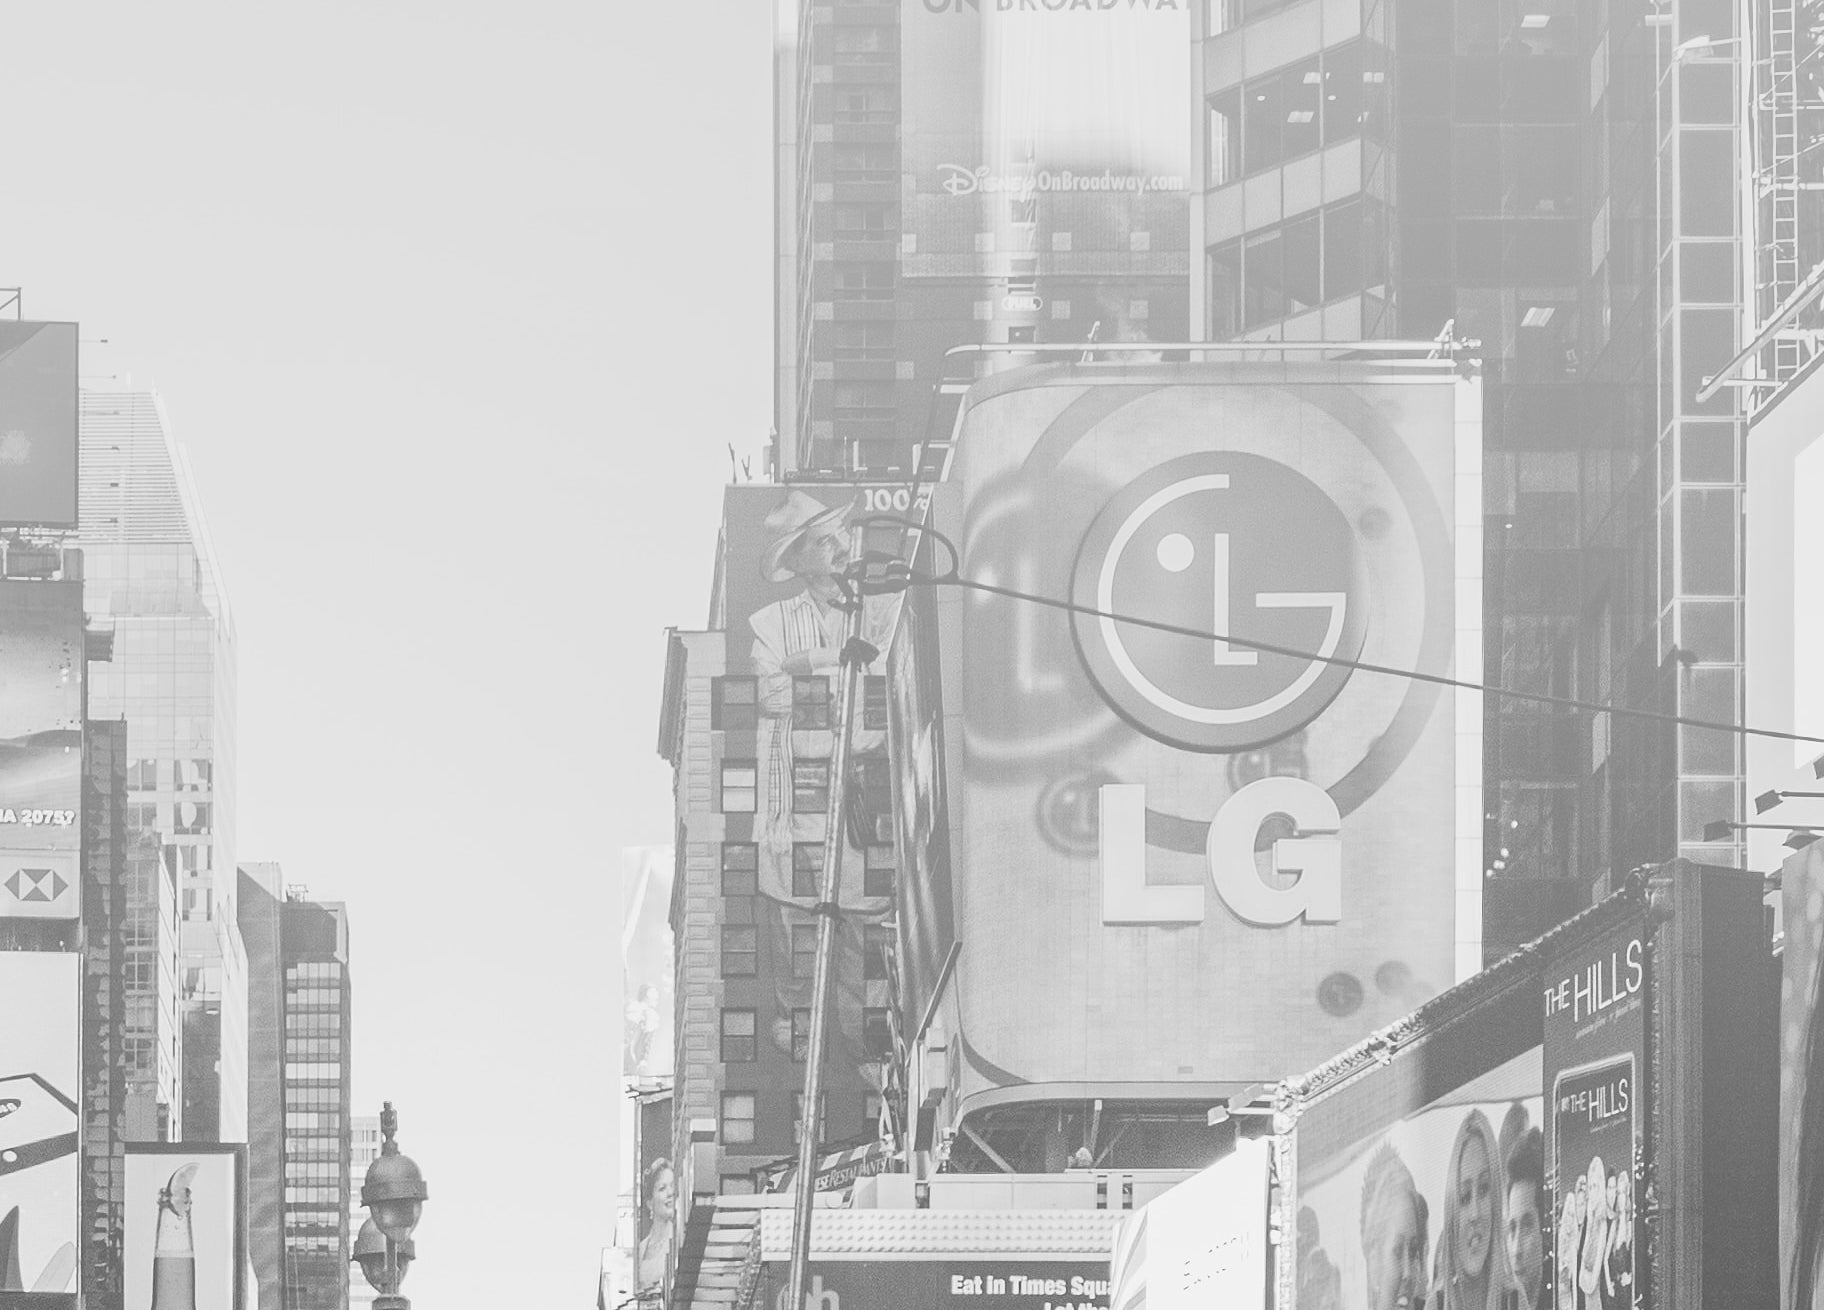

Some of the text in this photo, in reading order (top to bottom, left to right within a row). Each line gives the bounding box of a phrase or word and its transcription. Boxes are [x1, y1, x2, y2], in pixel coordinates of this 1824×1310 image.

[20, 808, 75, 827] 2075?
[1099, 776, 1342, 927] LG
[1543, 978, 1571, 1018] THE
[1574, 938, 1643, 1023] HILLS
[1588, 1077, 1629, 1122] HILLS
[951, 1274, 1067, 1295] Eat In Times
